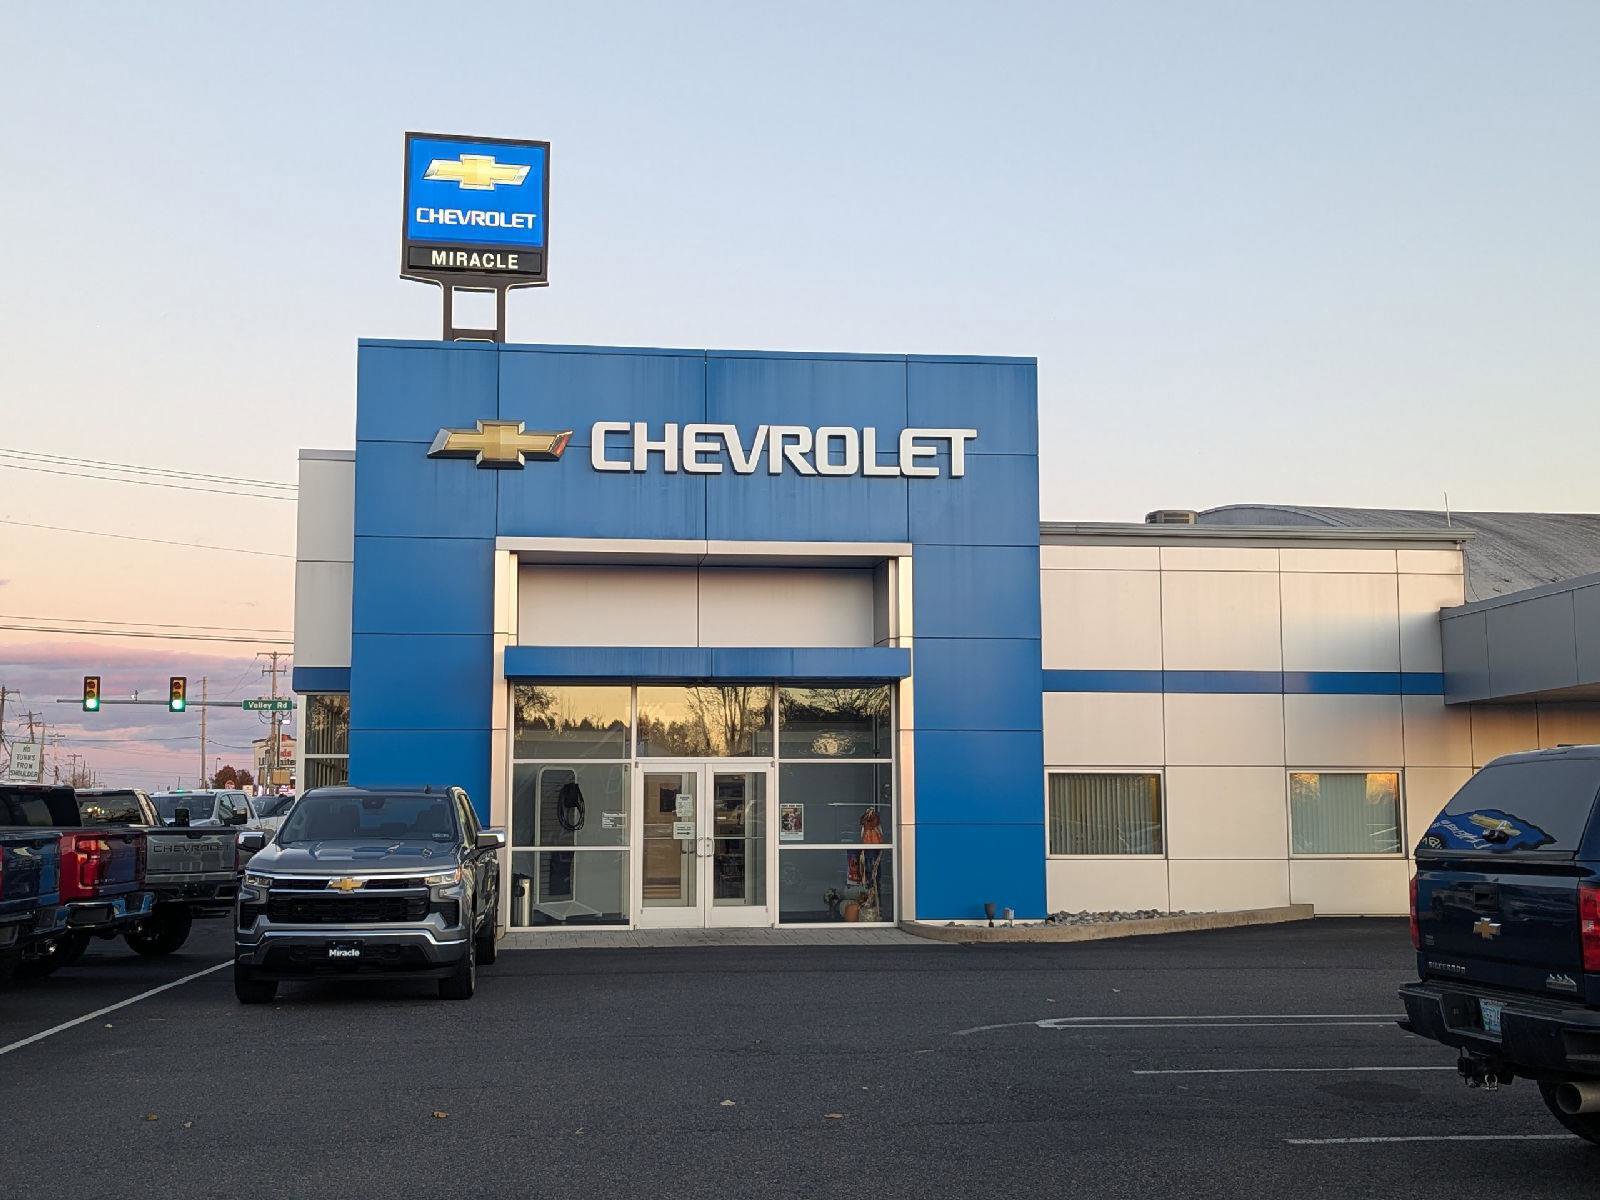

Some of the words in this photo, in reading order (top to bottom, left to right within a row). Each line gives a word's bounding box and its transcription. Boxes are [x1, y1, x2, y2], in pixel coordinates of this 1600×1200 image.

[416, 207, 537, 229] CHEVROLET
[431, 250, 519, 269] MIRACLE
[591, 421, 978, 478] CHEVROLET
[248, 701, 273, 710] Valley
[277, 701, 288, 709] Rd
[153, 842, 230, 853] CHEVROLET
[329, 948, 360, 957] Miracle
